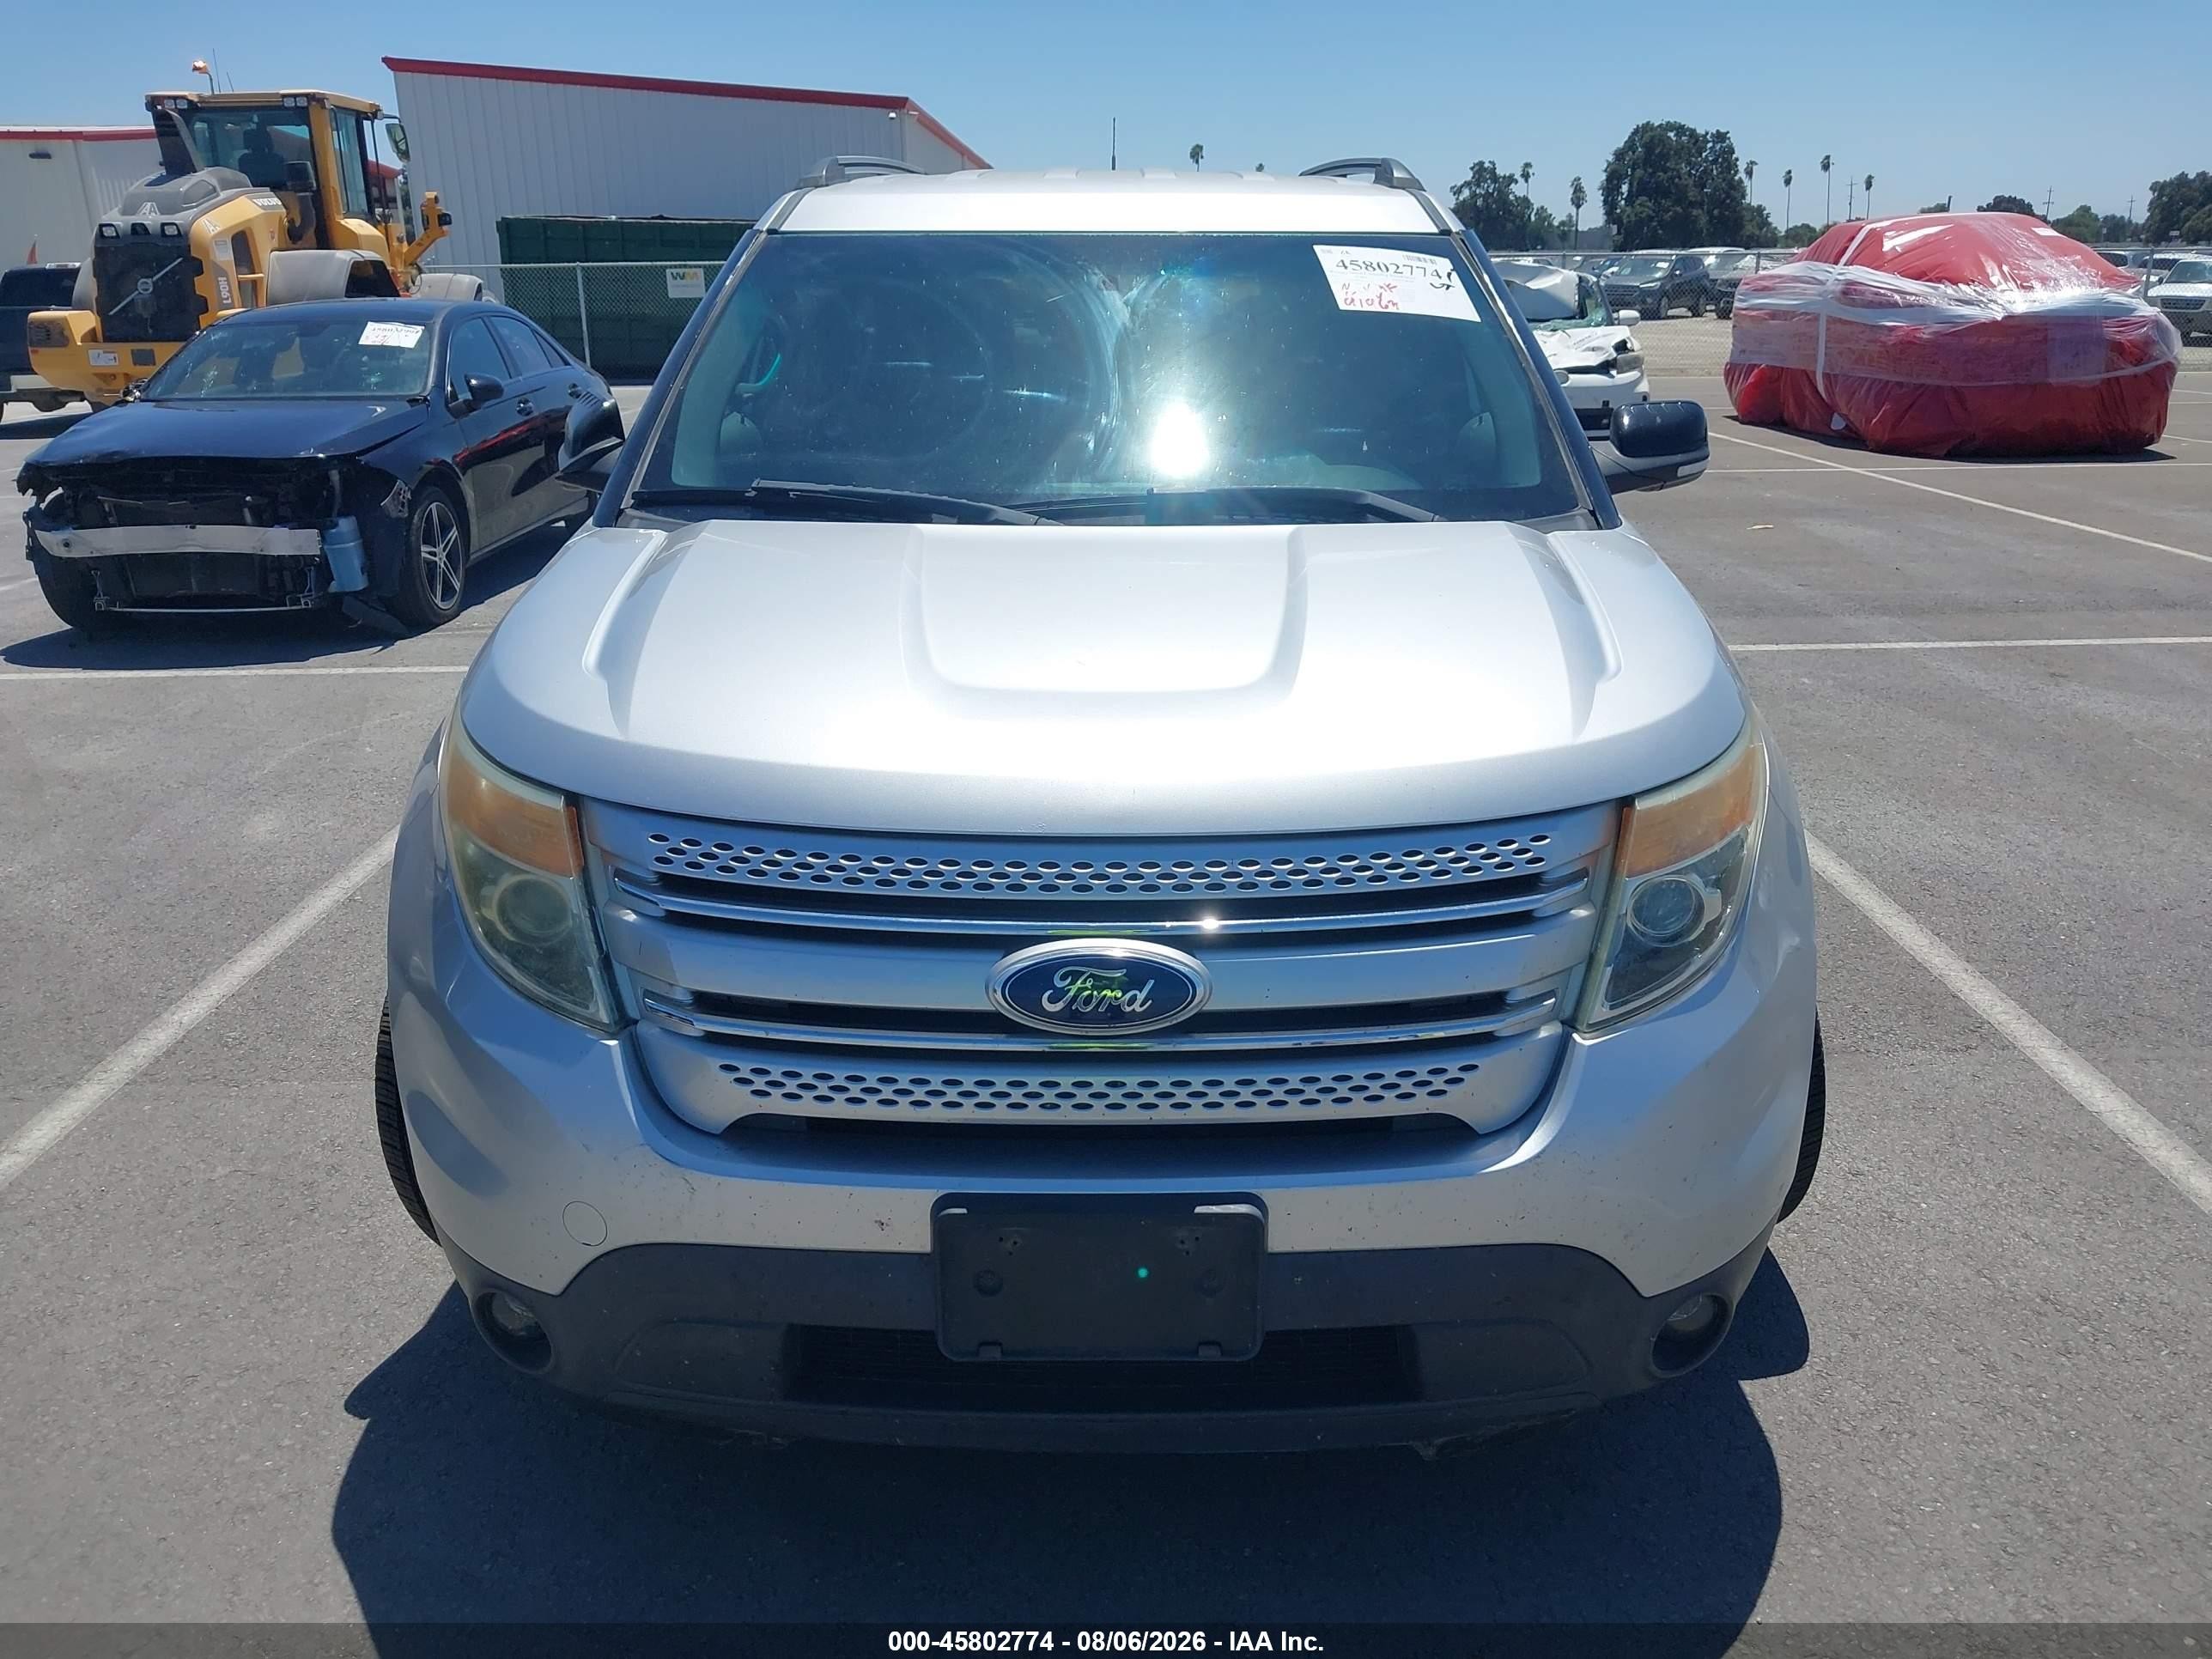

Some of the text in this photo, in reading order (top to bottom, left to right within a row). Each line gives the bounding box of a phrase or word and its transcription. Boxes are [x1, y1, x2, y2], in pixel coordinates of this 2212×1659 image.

[1335, 258, 1443, 280] 45802774
[217, 276, 232, 304] L90H
[1042, 966, 1155, 1012] Ford
